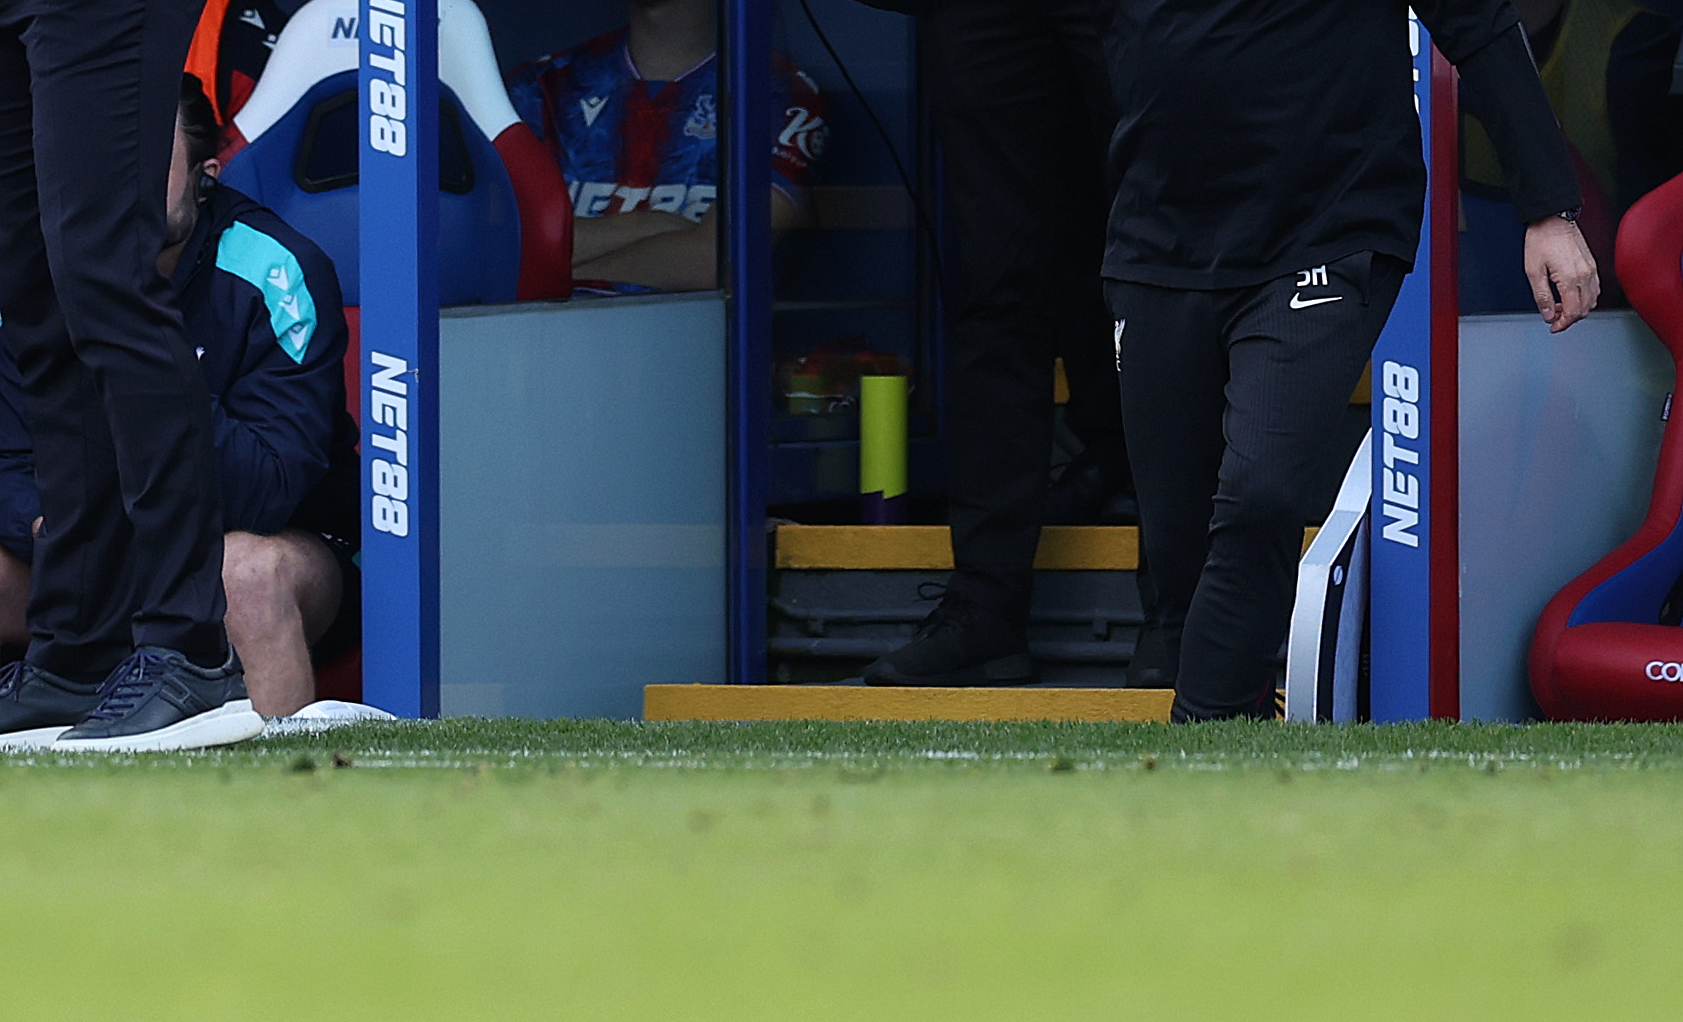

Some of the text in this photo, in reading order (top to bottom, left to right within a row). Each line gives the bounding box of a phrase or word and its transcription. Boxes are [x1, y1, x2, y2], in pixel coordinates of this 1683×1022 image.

[331, 17, 359, 39] N
[570, 181, 717, 223] ET88
[371, 351, 409, 538] NET88
[1381, 360, 1420, 548] NET88
[1645, 660, 1683, 682] CO
